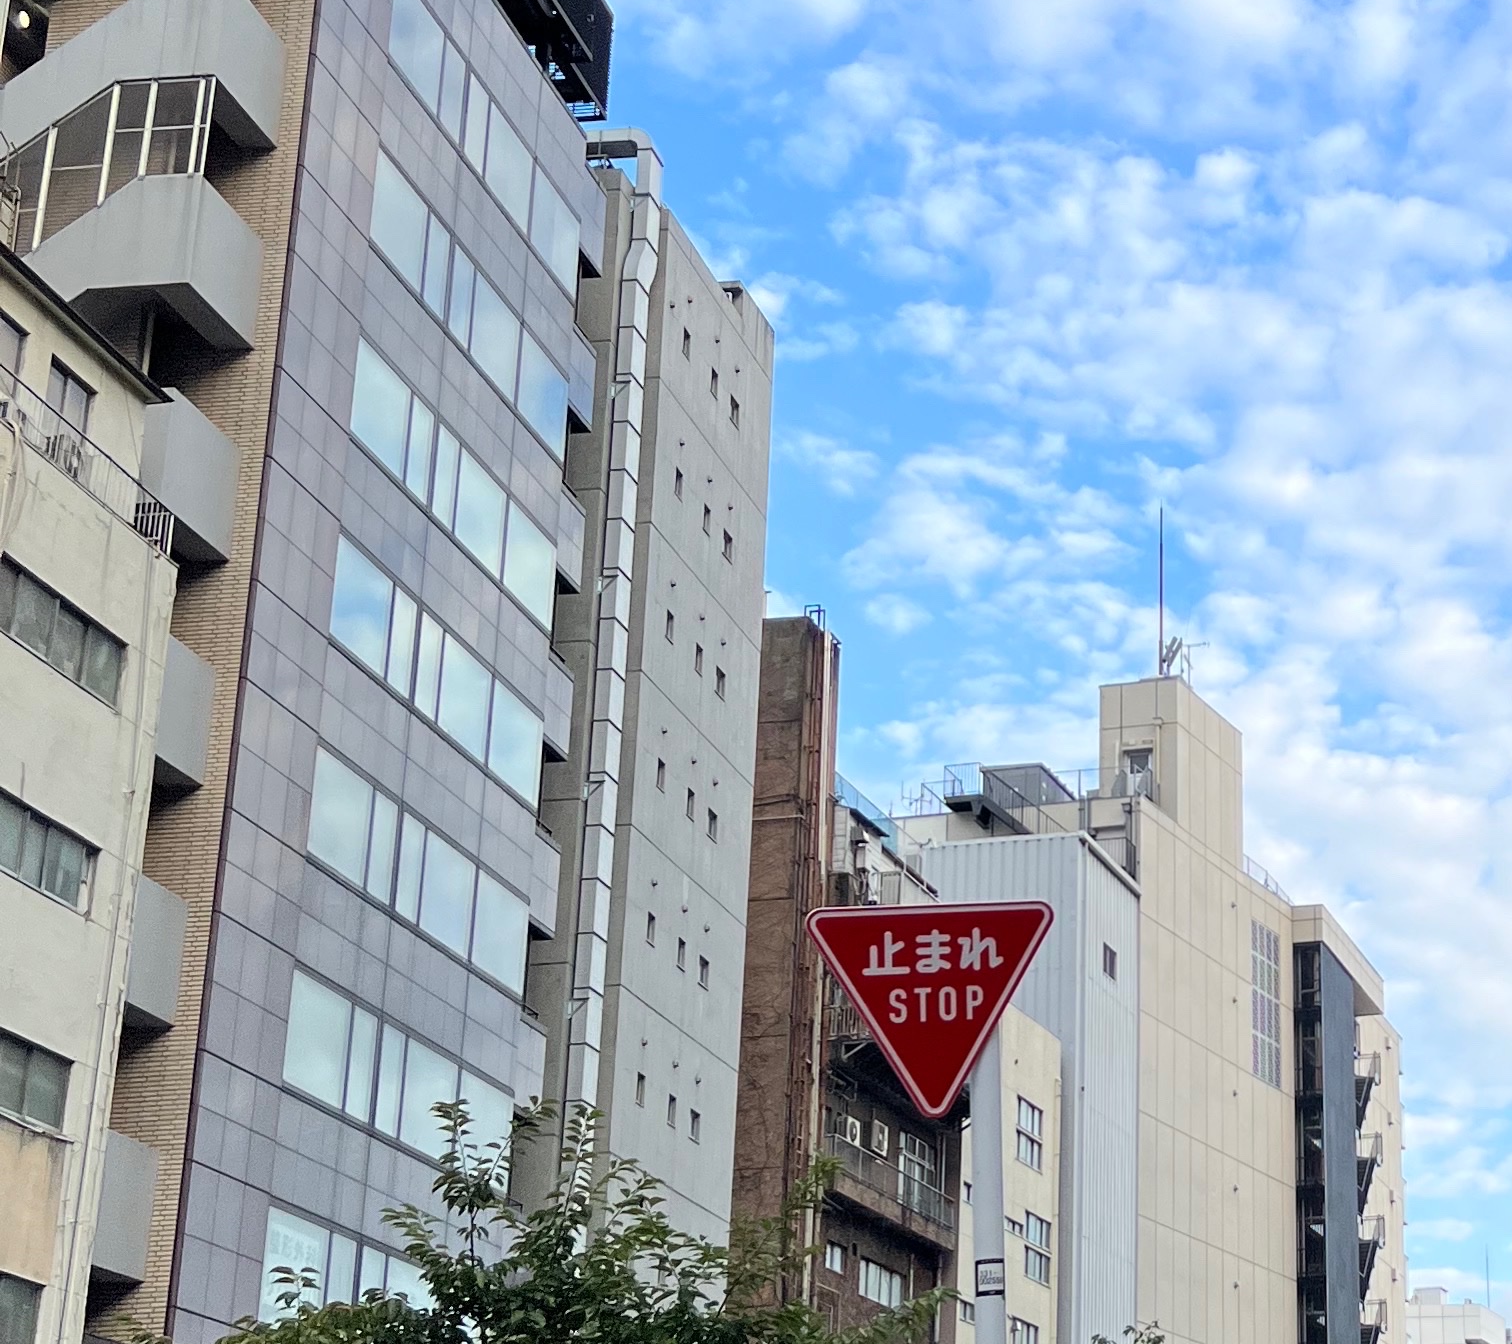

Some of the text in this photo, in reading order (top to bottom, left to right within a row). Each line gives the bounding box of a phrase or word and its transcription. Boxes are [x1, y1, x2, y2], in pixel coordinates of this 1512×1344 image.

[862, 927, 1004, 976] 止まれ
[888, 984, 984, 1024] STOP
